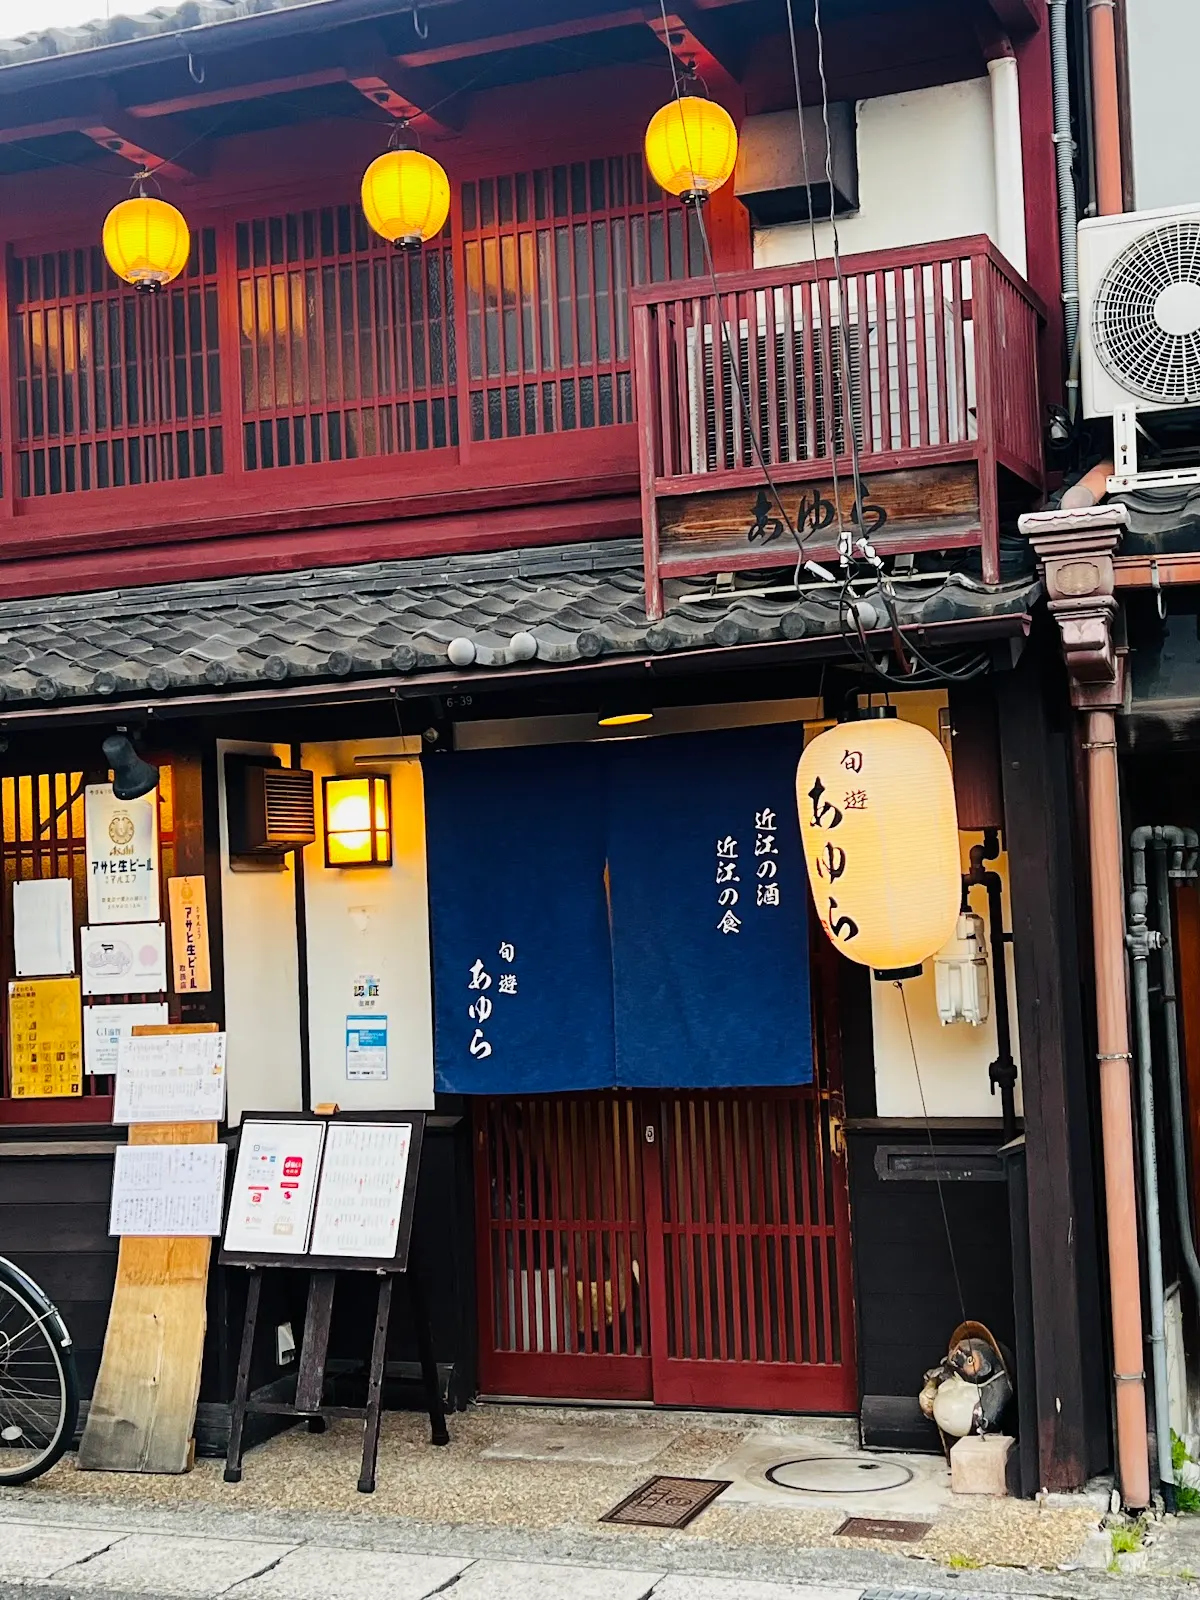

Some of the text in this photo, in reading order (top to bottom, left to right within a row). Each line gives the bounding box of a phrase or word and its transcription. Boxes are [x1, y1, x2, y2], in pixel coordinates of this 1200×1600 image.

[748, 483, 887, 546] あゆら
[447, 696, 473, 708] 6-39
[841, 750, 869, 810] 旬遊
[91, 857, 154, 875] アサヒ生ビール
[109, 845, 134, 857] Asahi
[754, 807, 780, 907] 近江の酒
[808, 776, 859, 942] あゆら
[716, 835, 742, 934] 近江の食
[184, 906, 198, 989] アサヒ生ビール
[498, 941, 518, 995] 旬遊
[467, 958, 493, 1060] あゆら
